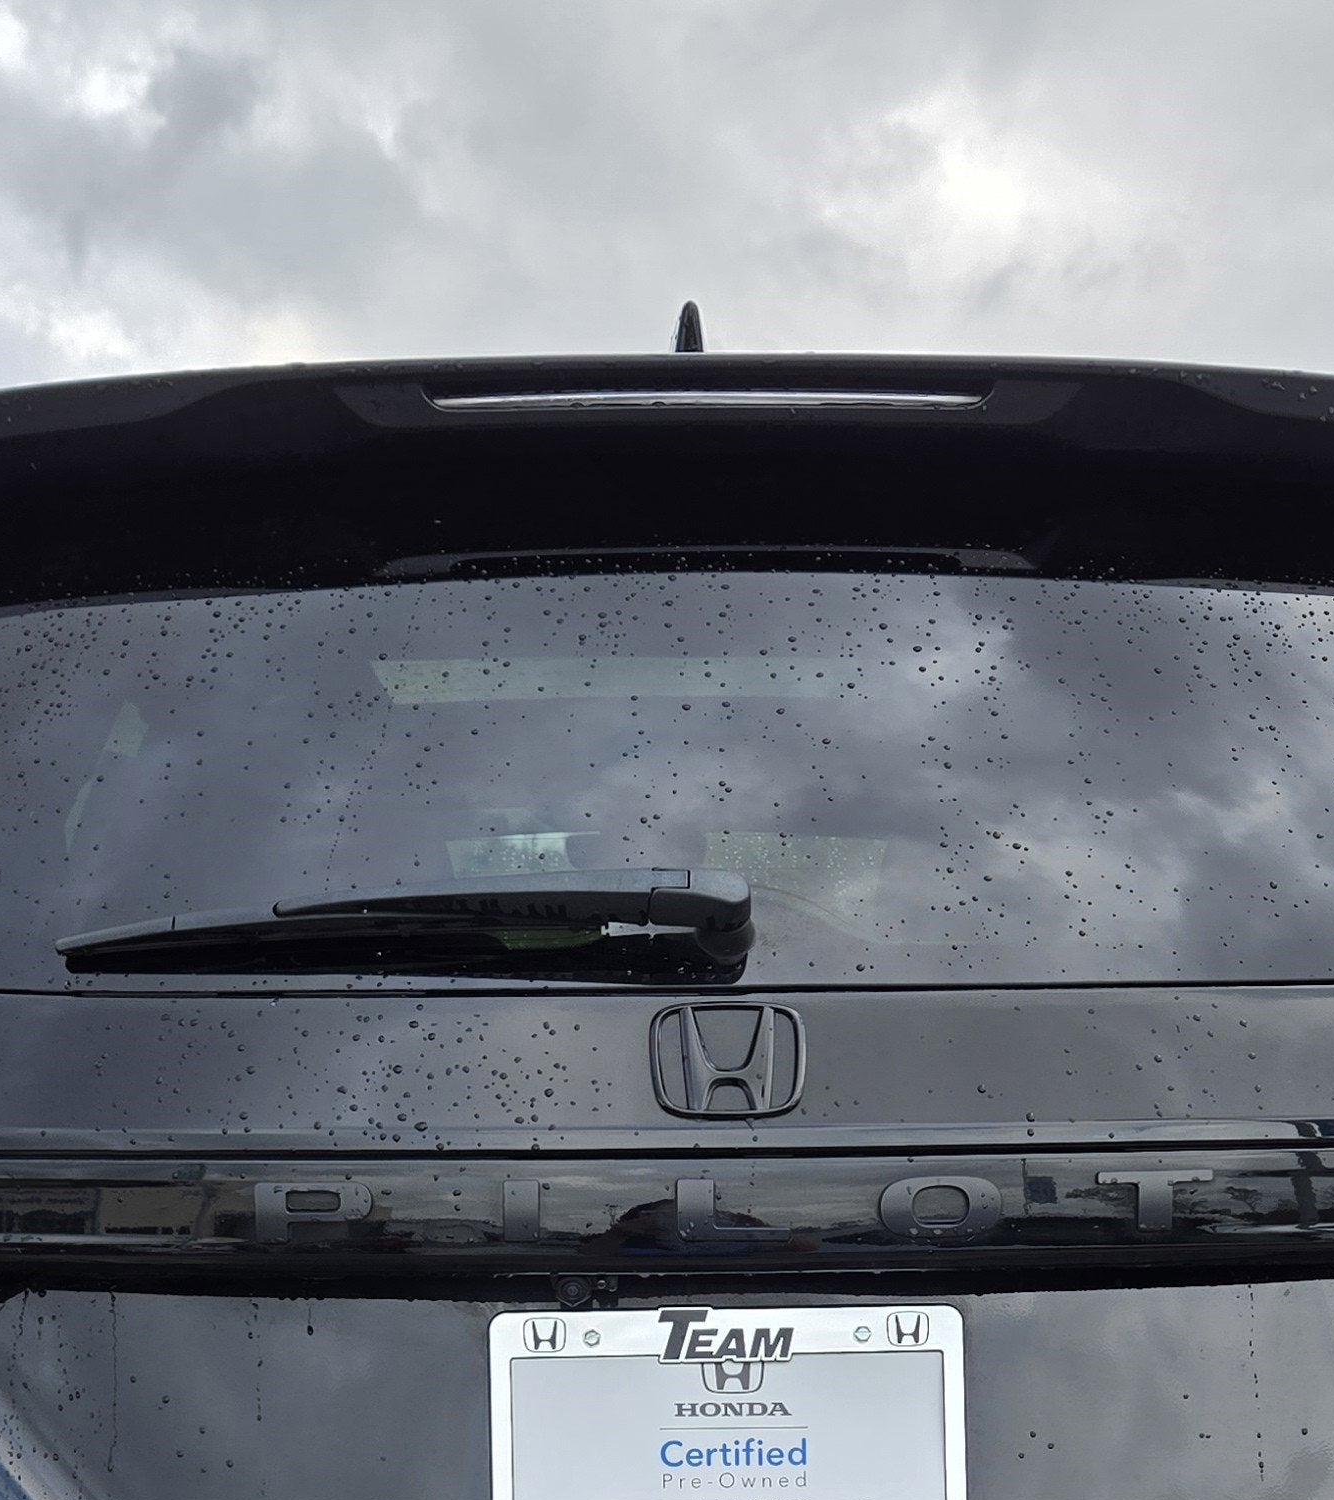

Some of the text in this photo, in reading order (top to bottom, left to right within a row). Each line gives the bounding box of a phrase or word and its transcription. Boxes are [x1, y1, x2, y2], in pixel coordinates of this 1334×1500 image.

[254, 1167, 1215, 1244] PILOT
[657, 1309, 794, 1361] TEAM
[674, 1402, 793, 1418] HONDA
[659, 1438, 808, 1468] Certified
[662, 1472, 808, 1489] Pre-Owned
